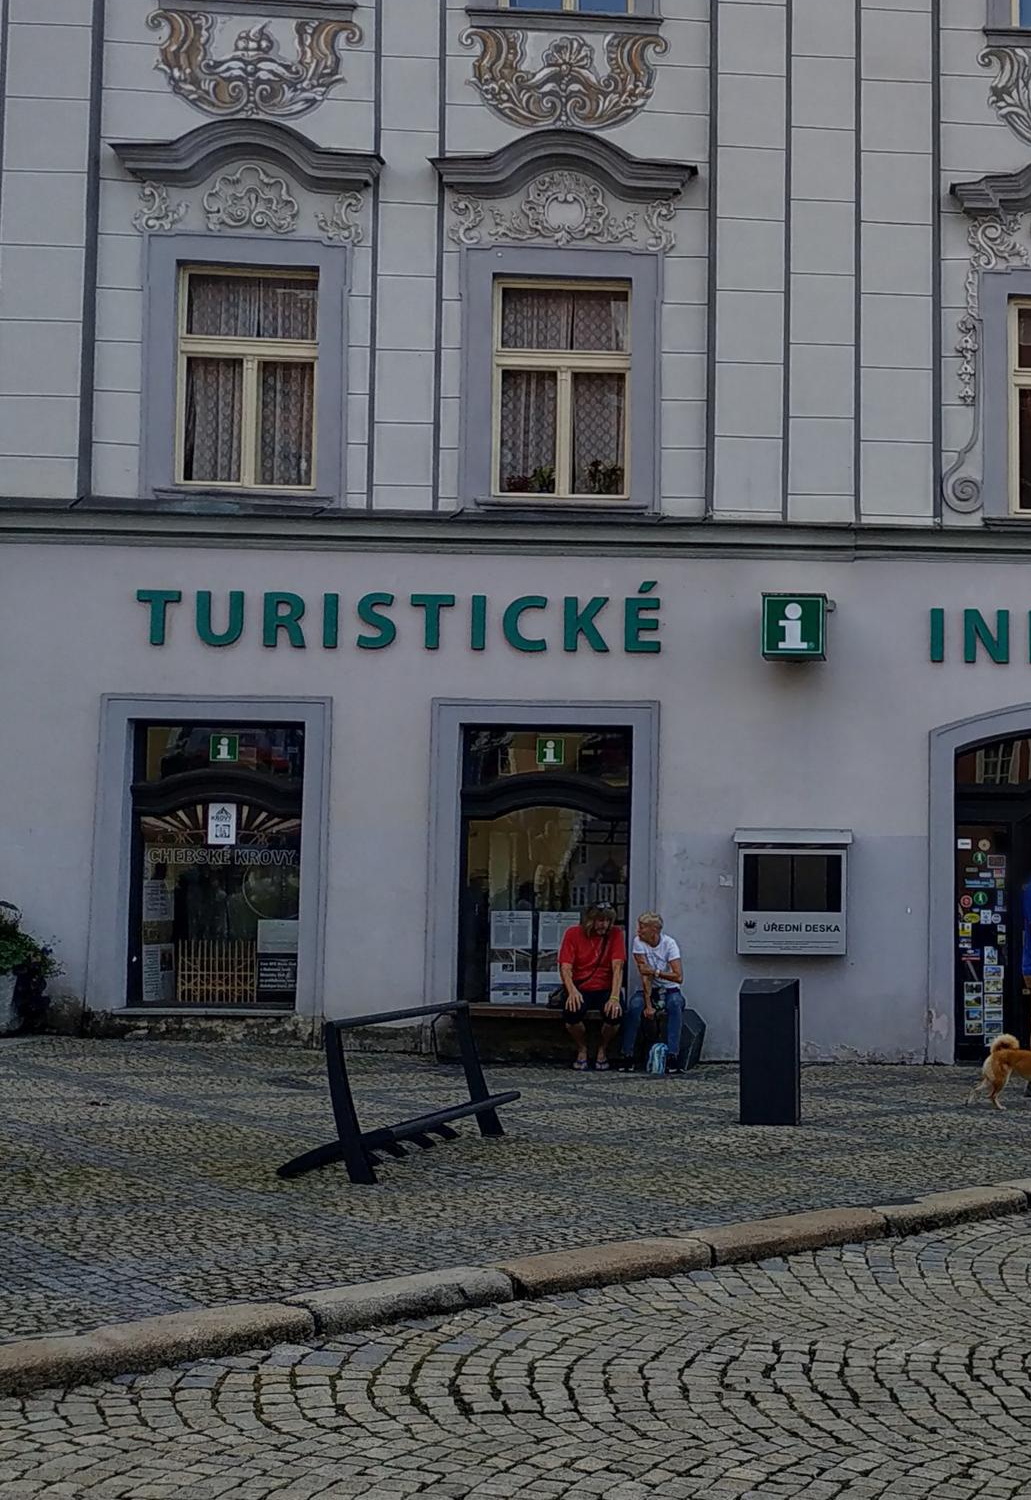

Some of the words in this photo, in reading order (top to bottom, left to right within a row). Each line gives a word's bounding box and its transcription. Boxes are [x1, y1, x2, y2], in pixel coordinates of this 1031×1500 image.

[137, 581, 661, 653] TURISTICKÉ
[147, 846, 230, 865] CHEBSKÉ
[234, 849, 296, 866] KROVY
[763, 922, 803, 932] ÚŘEDNÍ
[804, 924, 841, 933] DESKA
